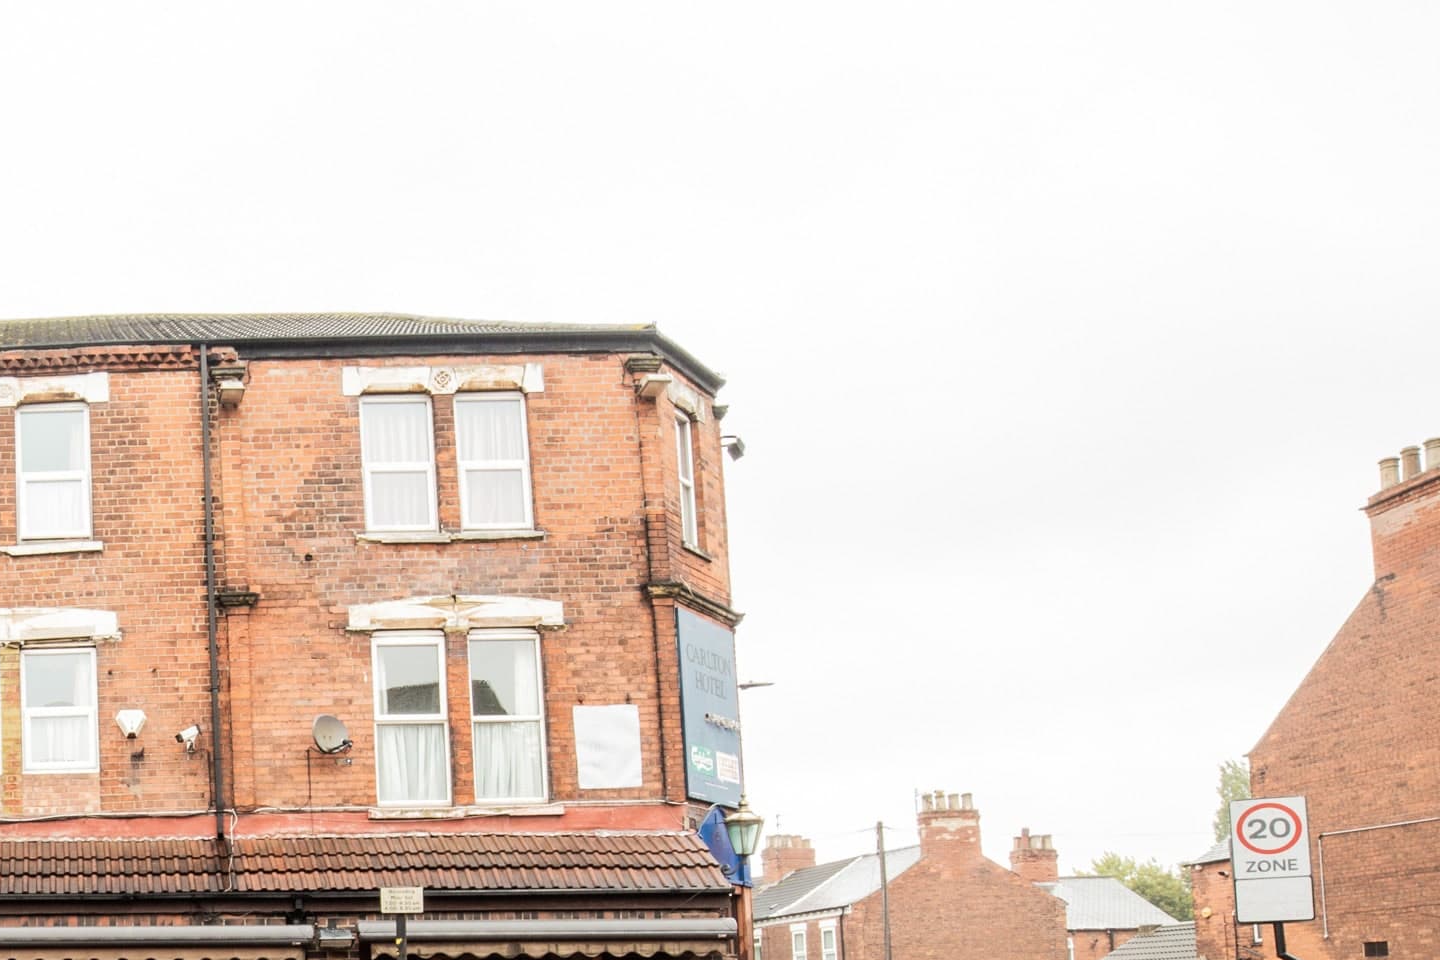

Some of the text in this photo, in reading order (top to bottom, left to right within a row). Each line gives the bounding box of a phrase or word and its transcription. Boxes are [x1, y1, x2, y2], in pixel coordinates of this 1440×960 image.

[686, 642, 731, 676] CARLTON
[695, 670, 727, 700] HOTEL
[1247, 817, 1291, 839] 20
[1246, 858, 1299, 873] ZONE
